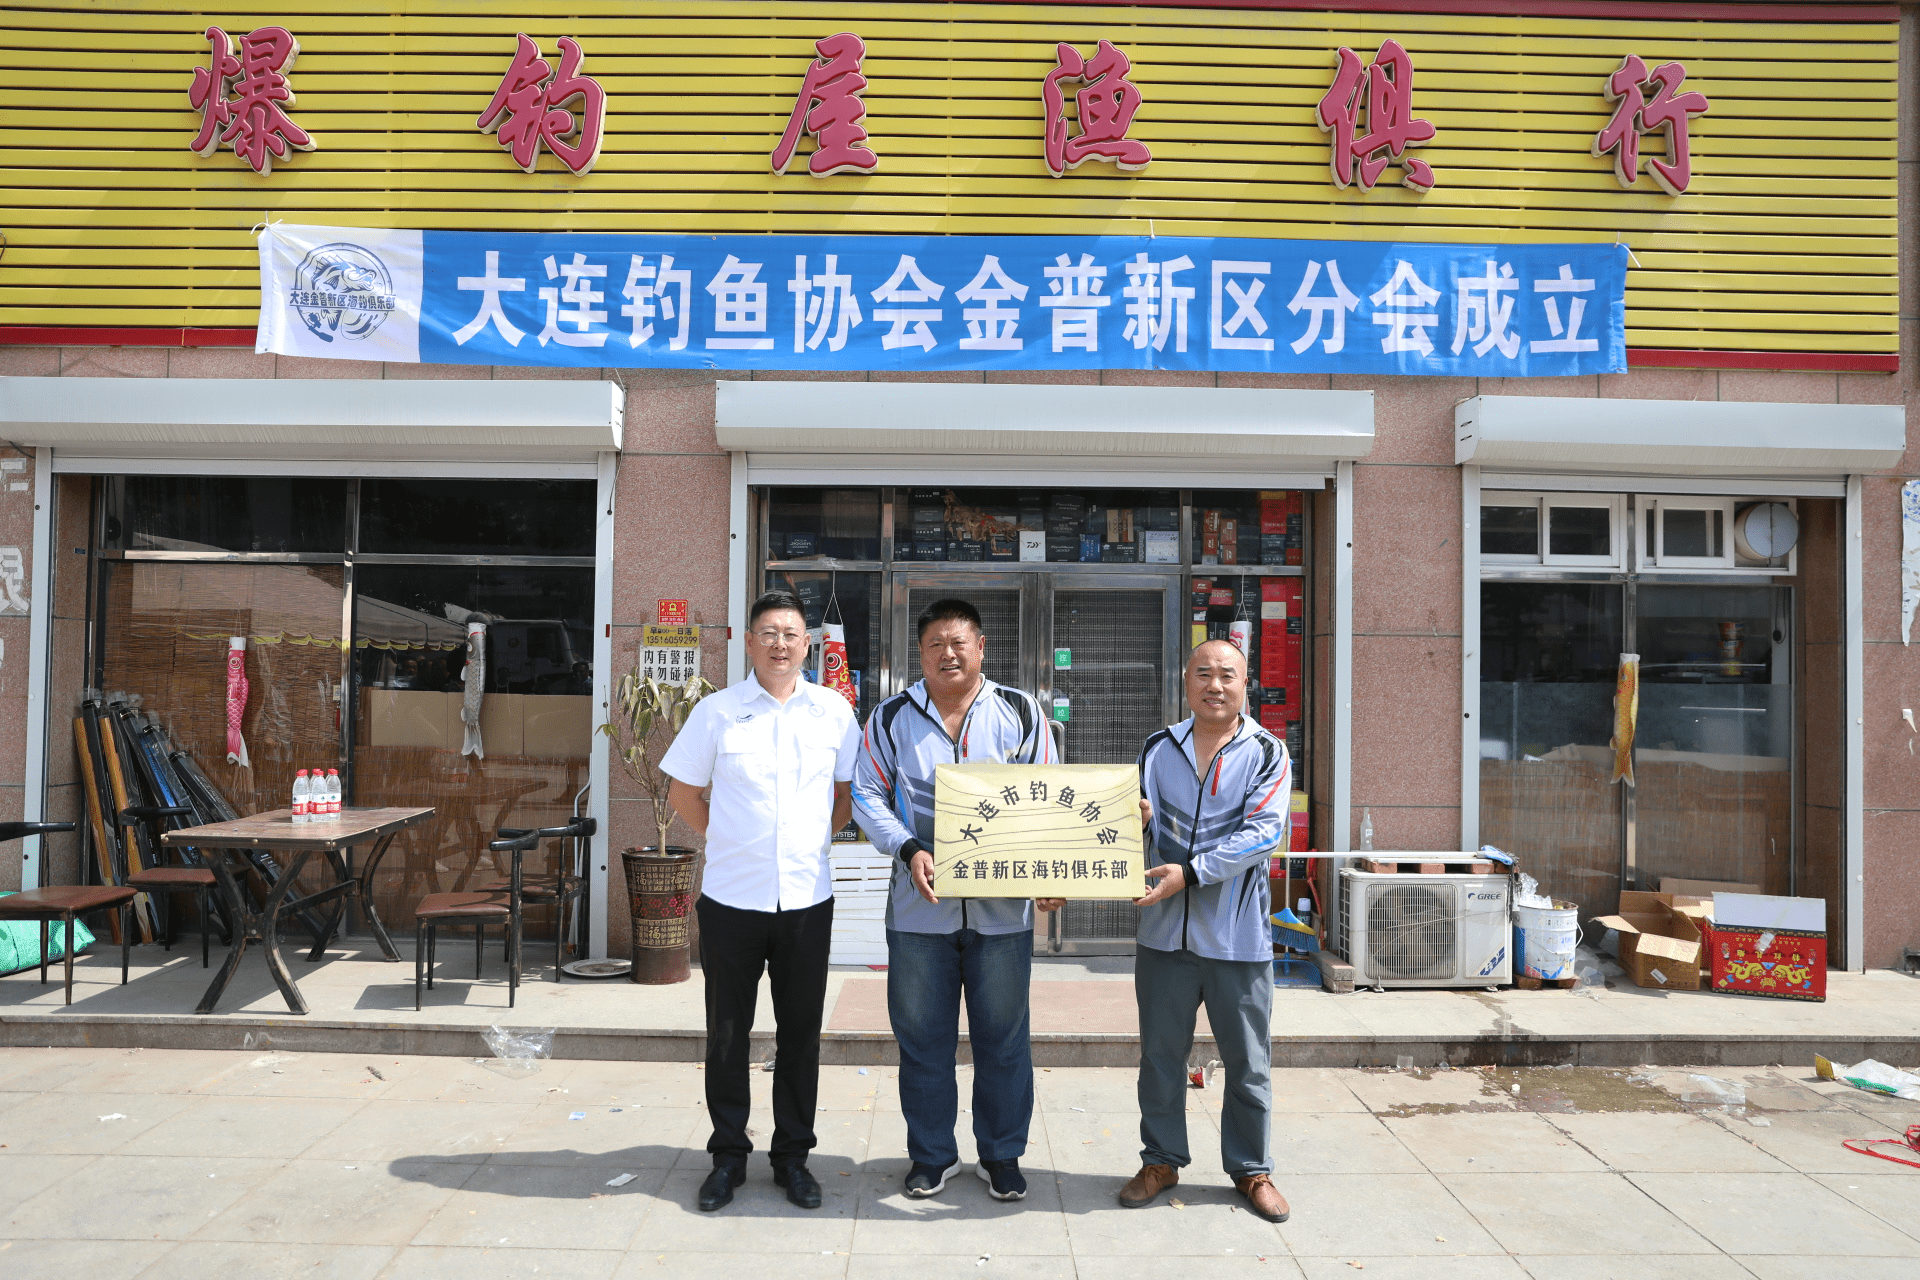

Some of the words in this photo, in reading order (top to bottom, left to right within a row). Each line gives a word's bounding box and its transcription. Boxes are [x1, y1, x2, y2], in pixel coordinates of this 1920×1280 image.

[289, 291, 396, 309] 大连金普新区海钓俱乐部
[453, 250, 1599, 359] 大连钓鱼协会金普新区分会成立
[646, 635, 698, 645] 13516059299
[644, 649, 695, 666] 内有警报
[959, 780, 1119, 845] 大连市钓鱼协会
[952, 859, 1129, 880] 金普新区海钓俱乐部
[1477, 892, 1502, 901] GREE
